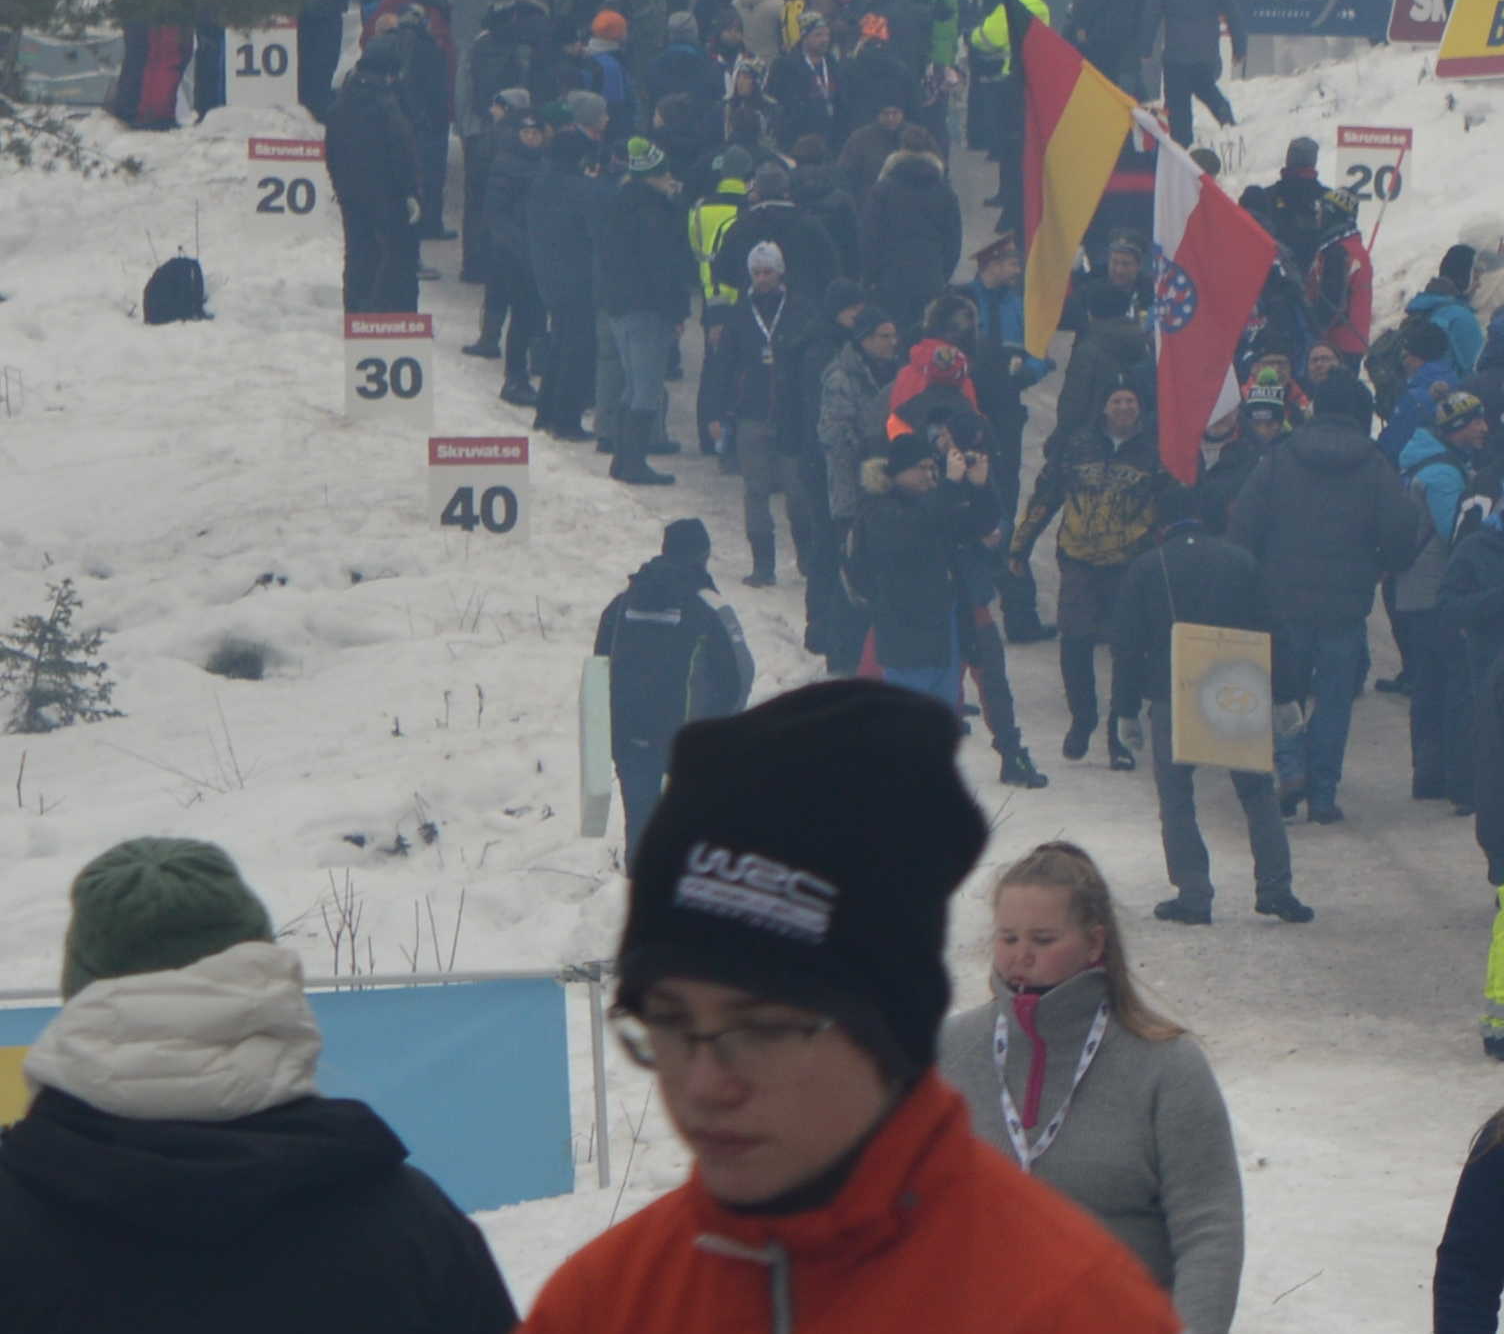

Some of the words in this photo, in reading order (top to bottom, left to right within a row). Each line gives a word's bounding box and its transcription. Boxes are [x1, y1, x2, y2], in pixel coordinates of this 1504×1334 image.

[236, 43, 288, 78] 10
[256, 176, 316, 215] 20
[1346, 164, 1402, 202] 20
[351, 320, 425, 335] Skruvat.se
[355, 357, 424, 400] 30
[436, 443, 521, 460] Skruvat.se
[440, 485, 519, 535] 40
